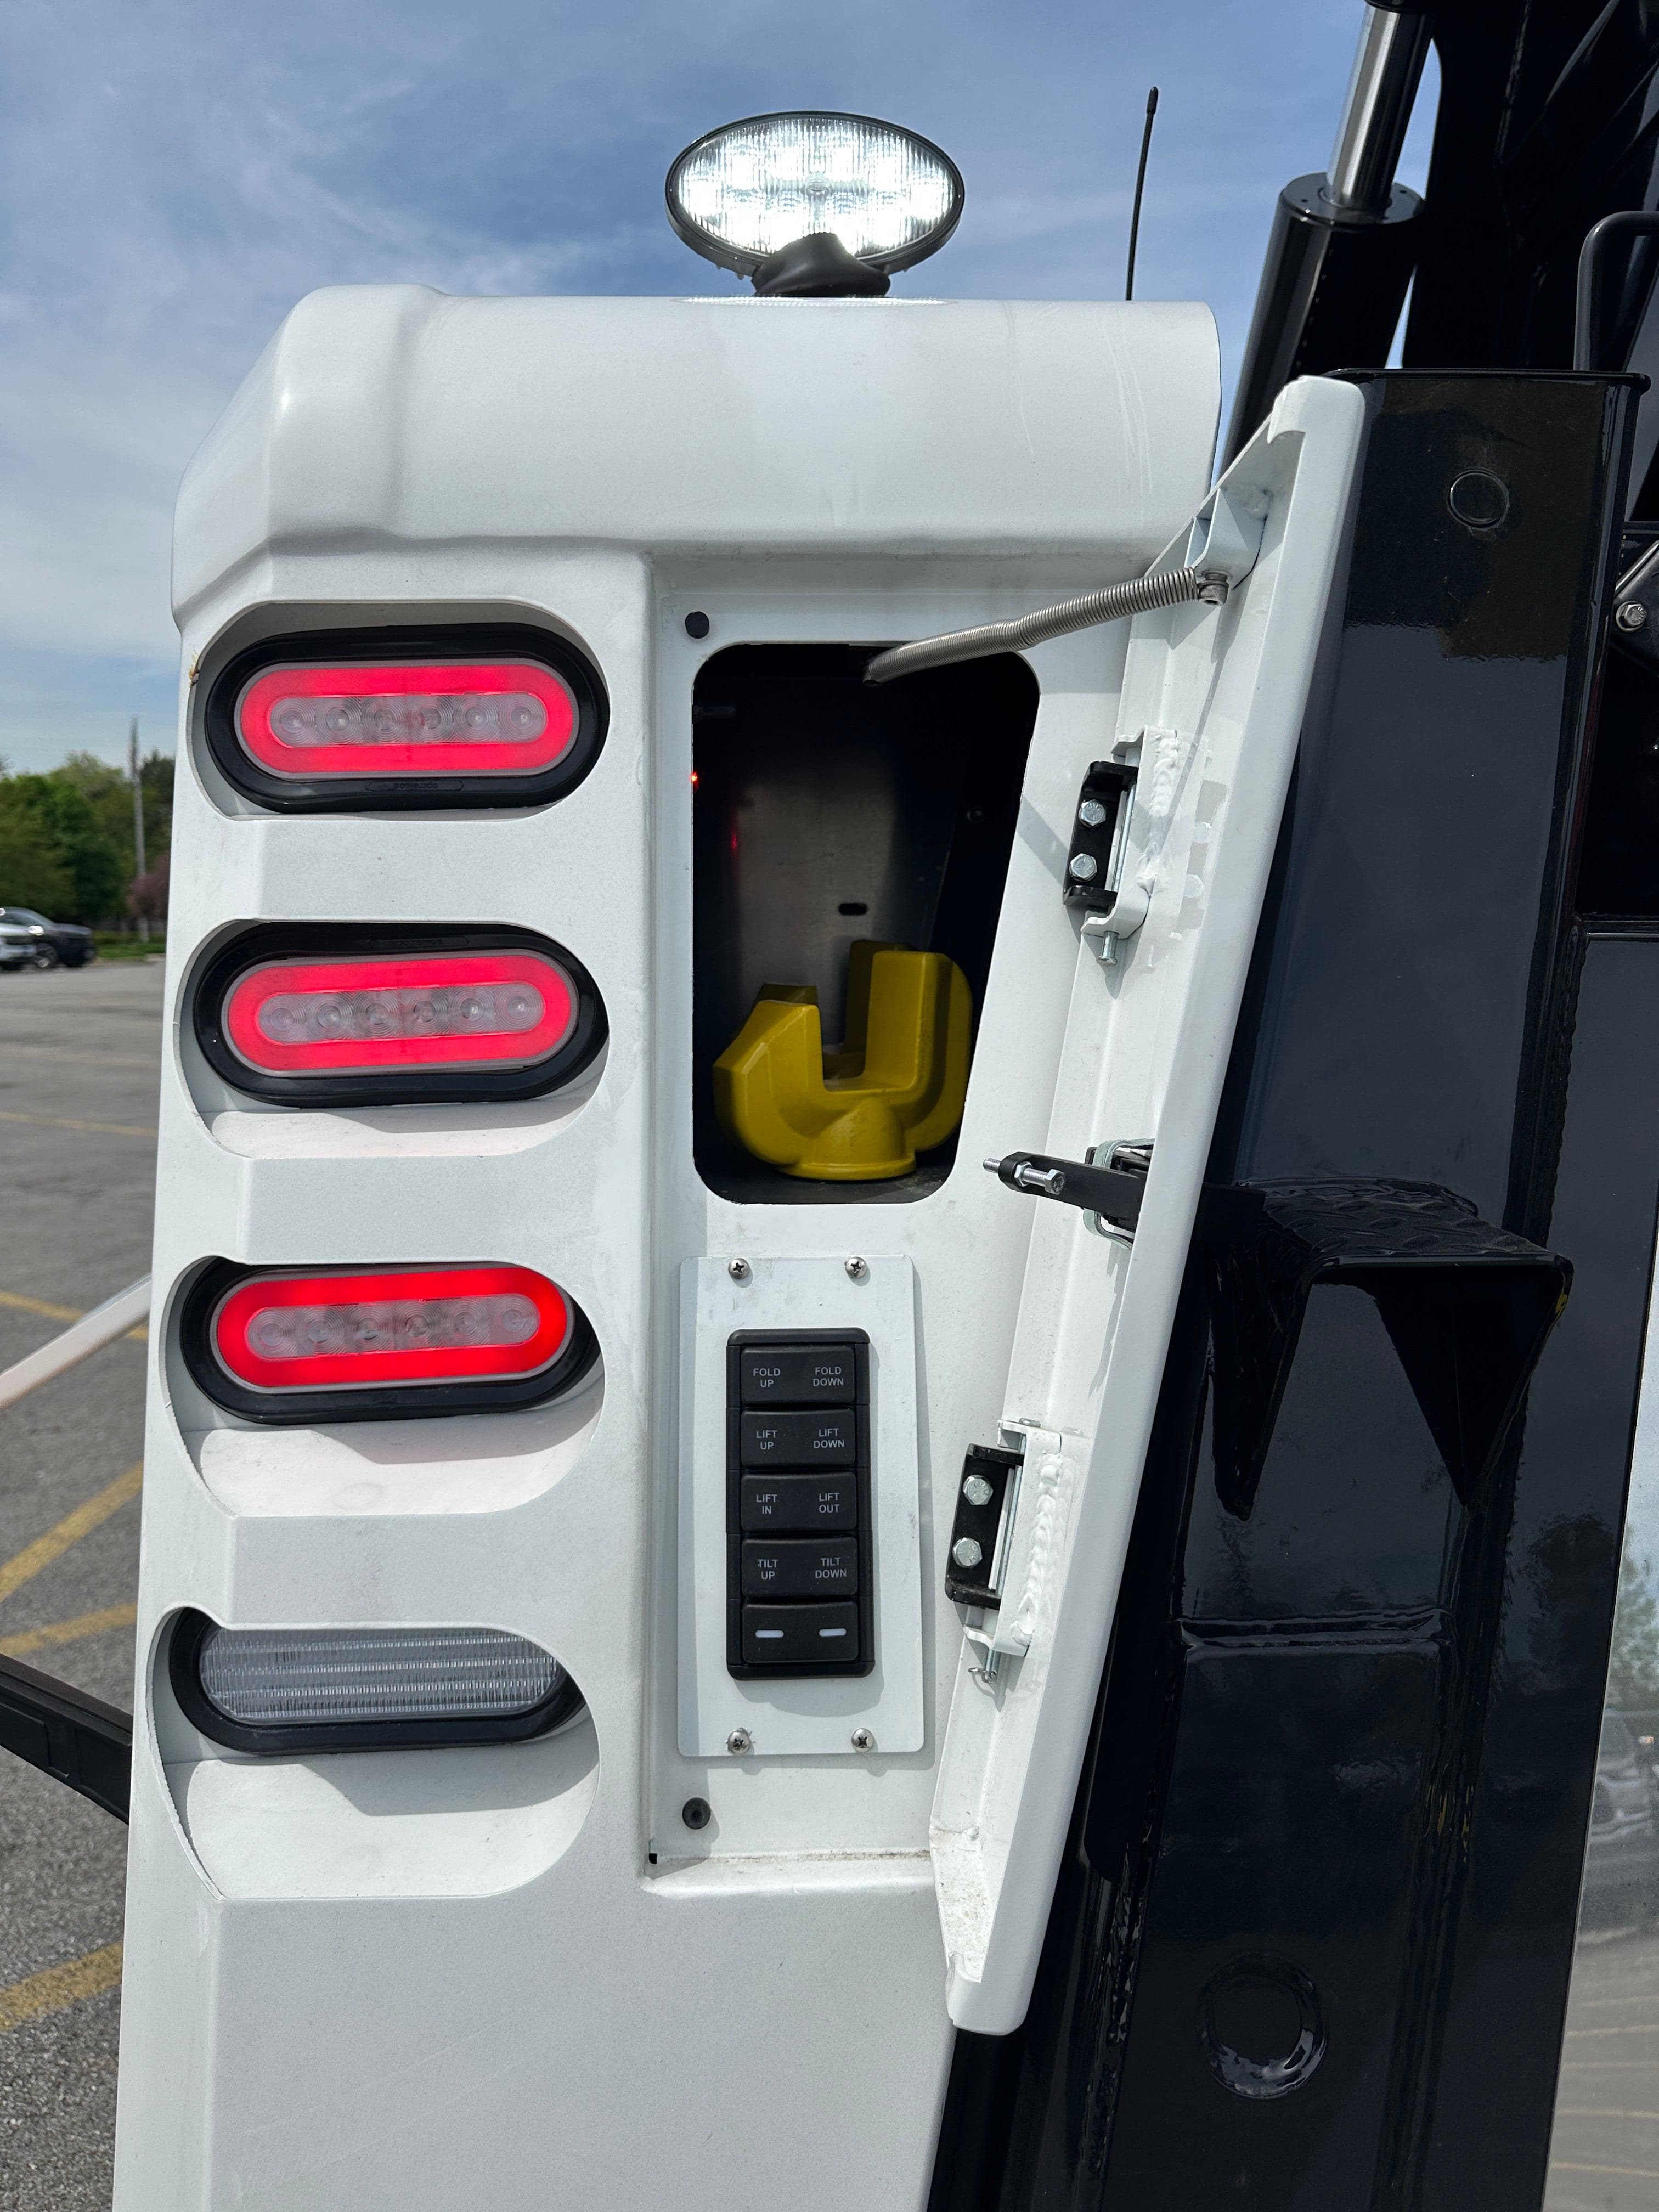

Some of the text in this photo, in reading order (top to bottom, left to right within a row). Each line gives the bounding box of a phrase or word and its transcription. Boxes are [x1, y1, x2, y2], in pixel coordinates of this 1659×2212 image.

[753, 1368, 781, 1376] FOLD
[815, 1367, 842, 1375] FOLD
[760, 1380, 774, 1388] UP
[812, 1378, 844, 1386] DOWN
[756, 1430, 777, 1438] LIFT
[819, 1428, 839, 1437] LIFT
[760, 1441, 774, 1450] UP
[813, 1440, 845, 1448] DOWN
[756, 1494, 777, 1503] LIFT
[819, 1492, 840, 1502] LIFT
[761, 1506, 772, 1514] IN
[819, 1504, 840, 1513] OUT
[758, 1559, 778, 1568] TILT
[821, 1557, 842, 1566] TILT
[761, 1571, 775, 1580] UP
[815, 1569, 847, 1579] DOWN
